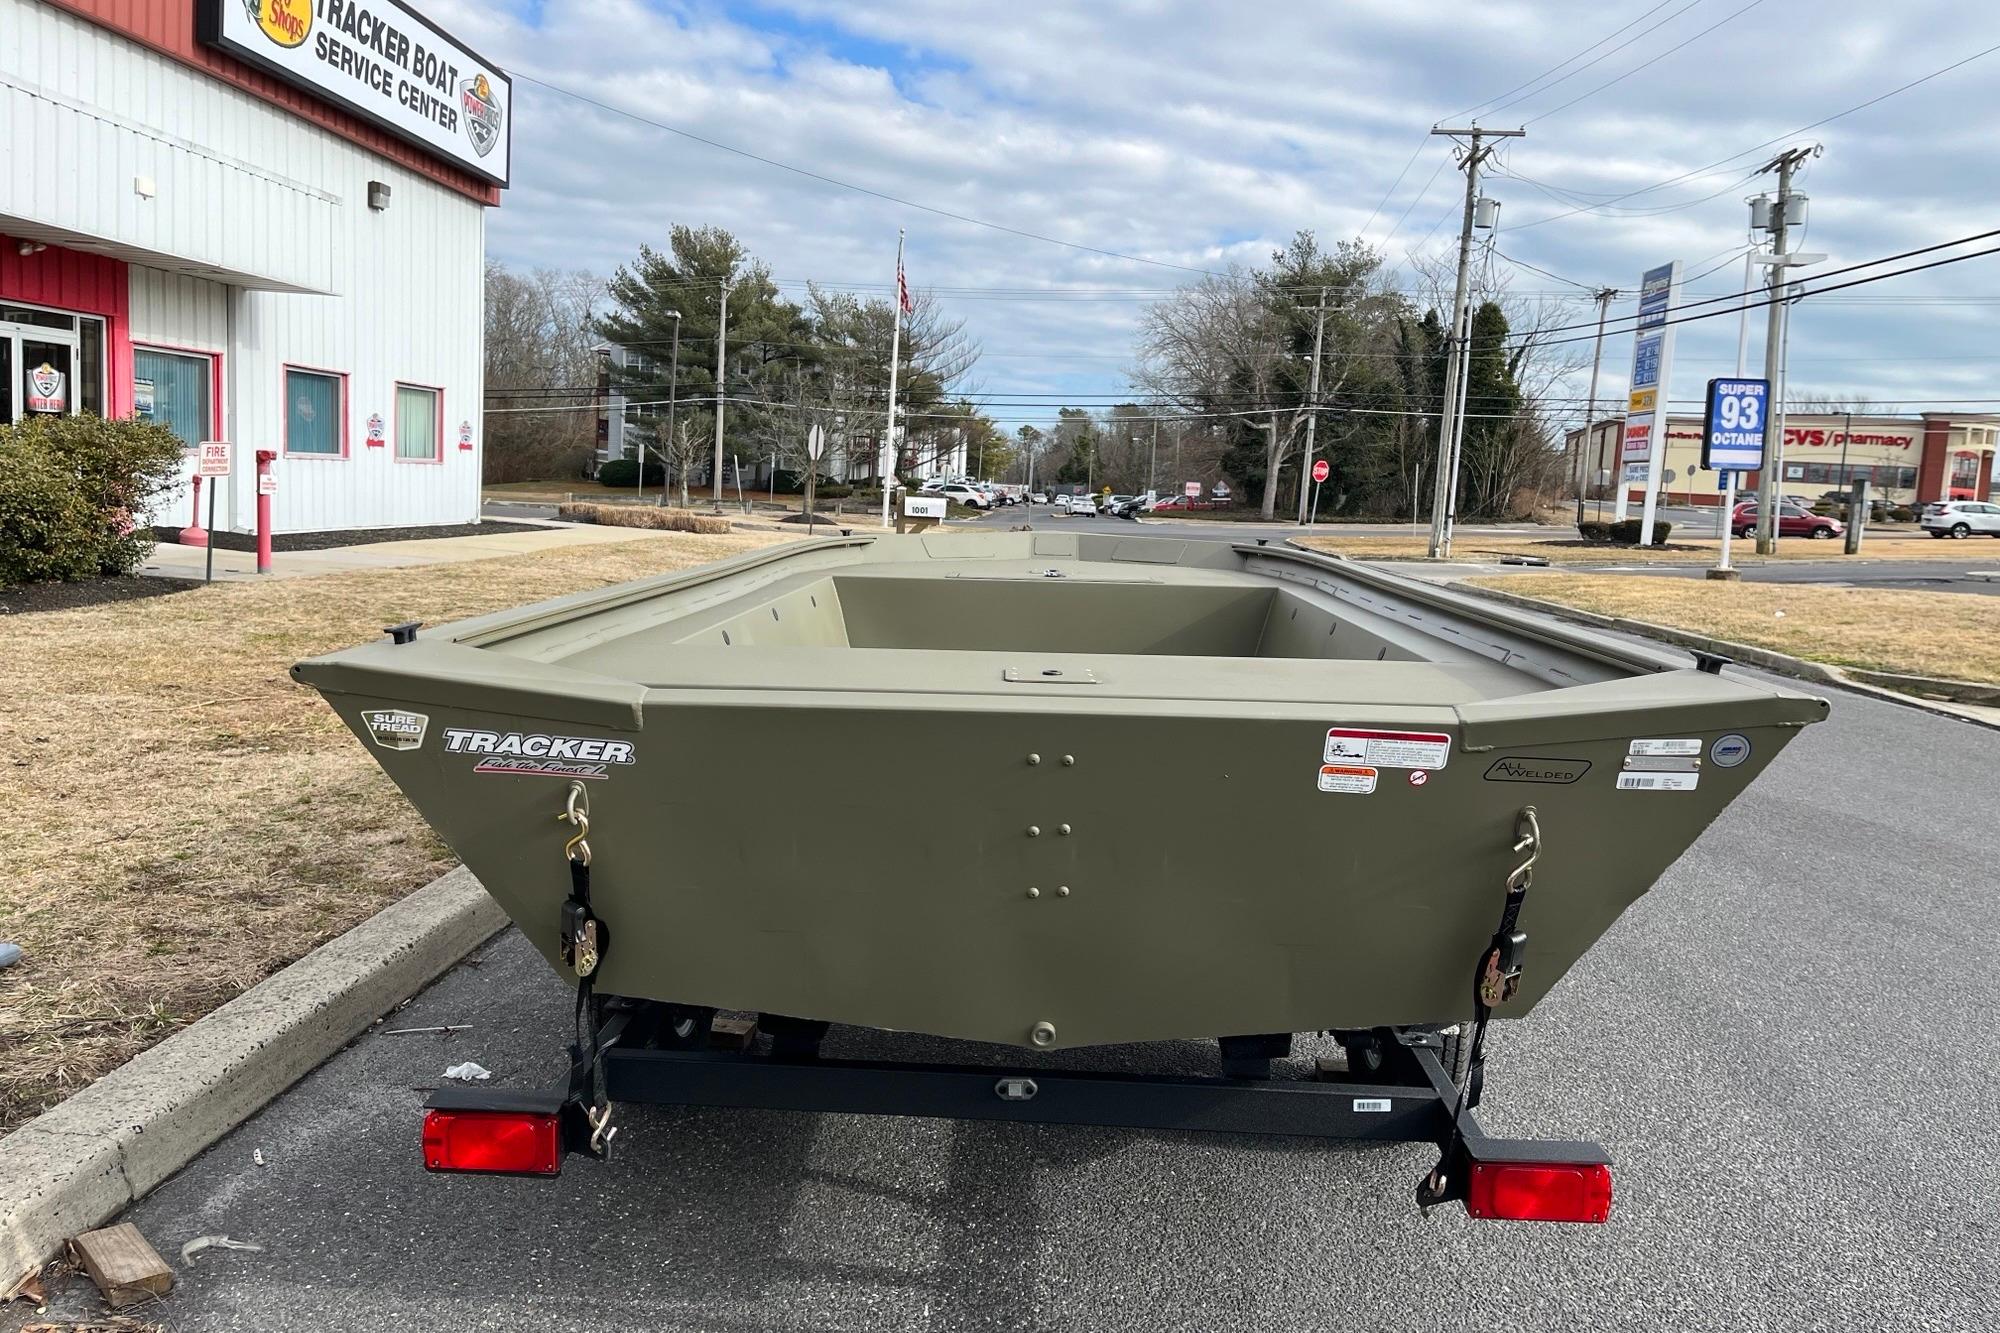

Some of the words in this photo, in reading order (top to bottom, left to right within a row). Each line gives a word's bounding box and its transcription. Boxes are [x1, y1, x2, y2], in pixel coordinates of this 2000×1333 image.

[269, 0, 304, 40] Shops
[412, 43, 459, 98] BOAT
[315, 31, 393, 98] SERVICE
[398, 79, 458, 134] CENTER
[1719, 384, 1764, 395] SUPER
[1721, 396, 1759, 429] 93
[1712, 432, 1763, 445] OCTANE
[206, 446, 226, 457] FIRE
[1312, 466, 1328, 476] STOP
[912, 506, 928, 514] 1001
[373, 713, 417, 725] SURE
[371, 722, 422, 733] TREAD
[445, 730, 633, 763] TRACKER
[480, 759, 513, 768] Fish
[516, 761, 539, 770] the
[1495, 762, 1526, 771] ALL
[1505, 767, 1574, 779] WELDED
